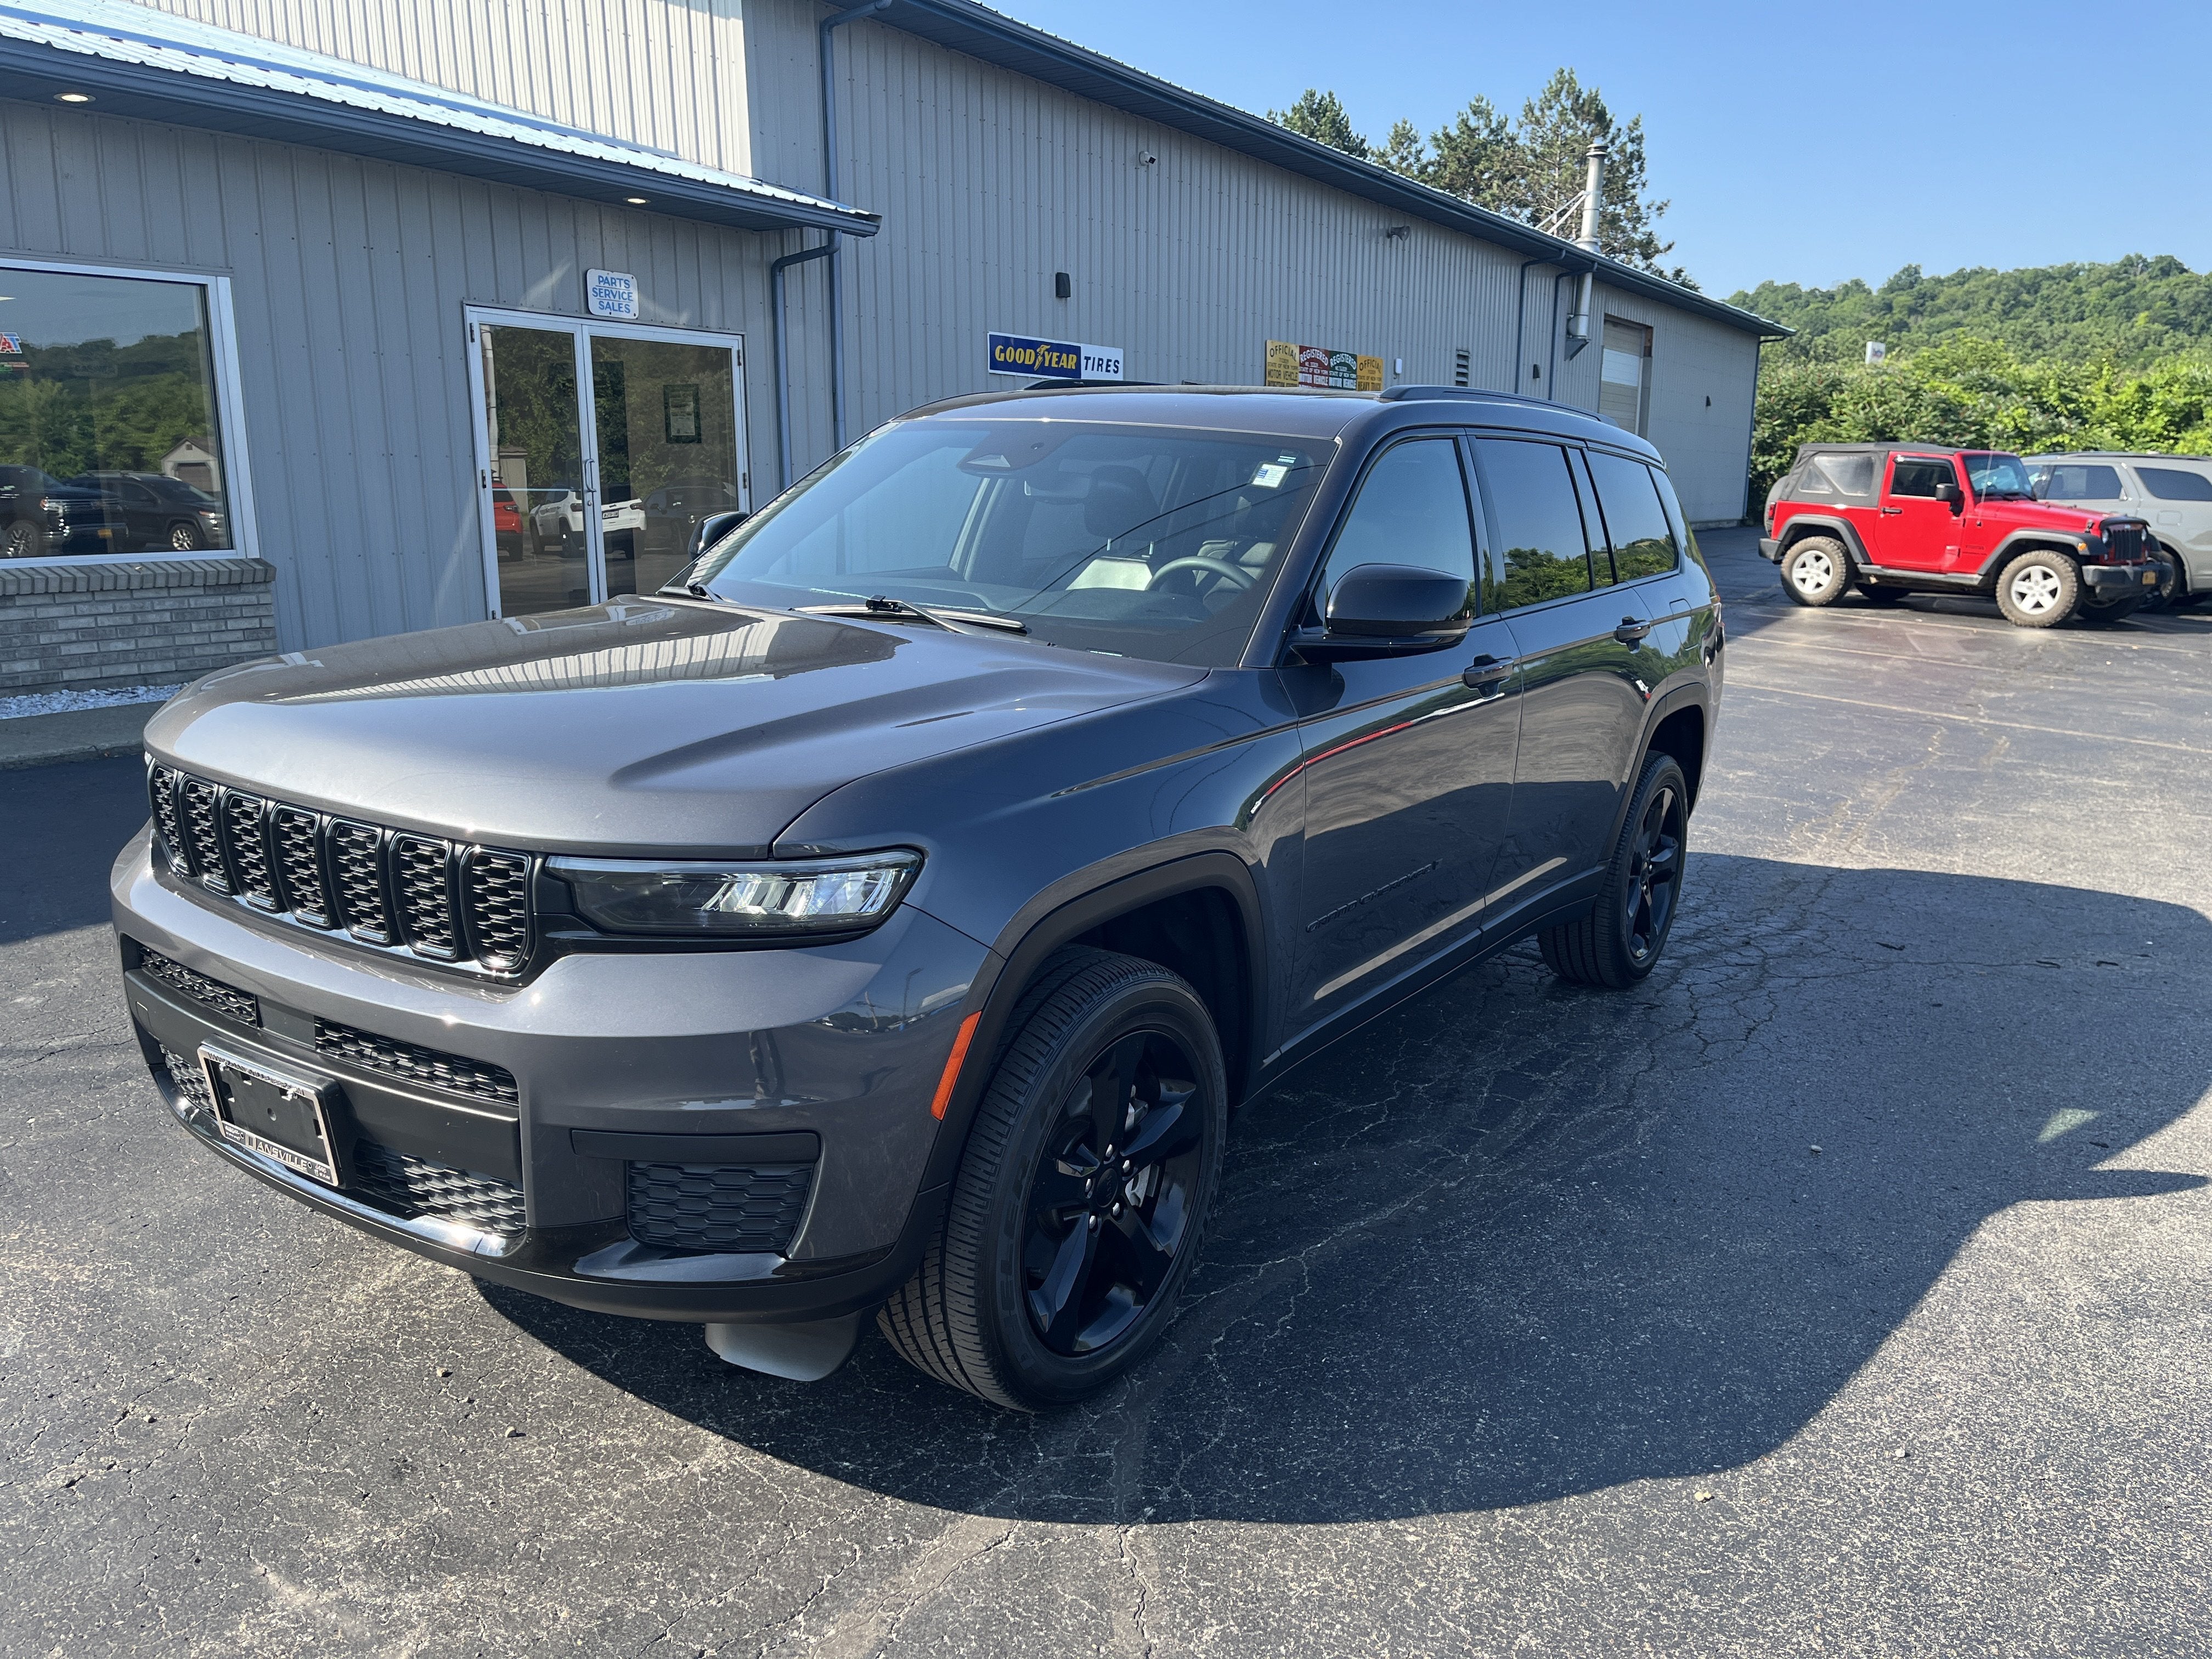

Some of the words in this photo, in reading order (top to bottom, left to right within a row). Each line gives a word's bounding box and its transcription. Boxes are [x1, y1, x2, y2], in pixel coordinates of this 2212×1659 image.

[598, 275, 630, 289] PARTS
[592, 287, 634, 301] SERVICE
[599, 301, 630, 313] SALES
[1269, 345, 1297, 362] OFFICIAL
[1300, 348, 1328, 366] REGISTERED
[1330, 353, 1357, 370] REGISTERED
[1084, 356, 1120, 374] TIRES
[1359, 359, 1381, 374] OFFICIAL
[1305, 900, 1358, 933] GRAND
[245, 1134, 308, 1170] DANSVILLE
